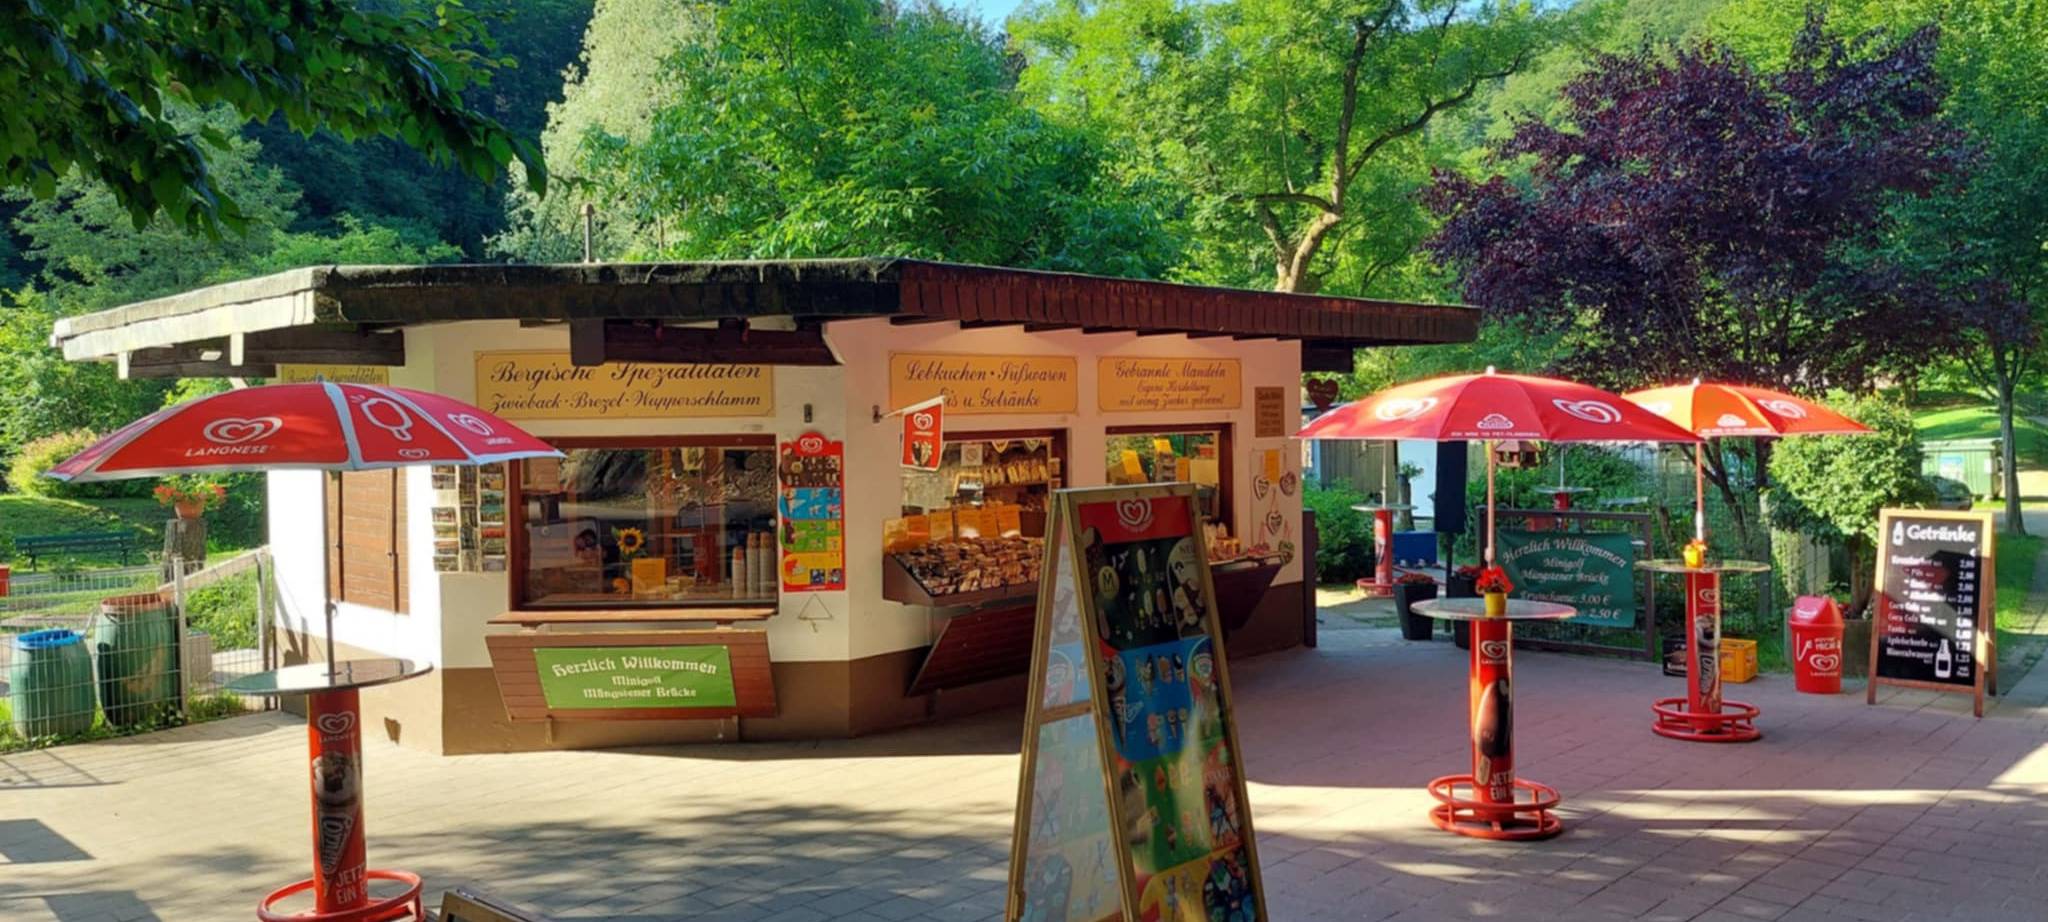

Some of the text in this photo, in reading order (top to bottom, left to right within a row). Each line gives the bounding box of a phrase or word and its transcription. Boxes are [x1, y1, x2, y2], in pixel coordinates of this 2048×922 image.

[491, 361, 595, 391] Bergische
[906, 361, 1067, 384] Lebkuchen Süßwaren
[1115, 360, 1225, 378] Gebrannte Mandeln
[491, 390, 760, 413] Zwieback Brezel Wupperschlamm
[980, 387, 1041, 408] Getränke
[184, 445, 269, 457] LANGNESE
[1907, 524, 1976, 542] Getränke
[1503, 537, 1627, 568] Herzlich Willkommen
[1543, 557, 1585, 569] Minigolf
[552, 656, 717, 677] Herzlich Willkommen
